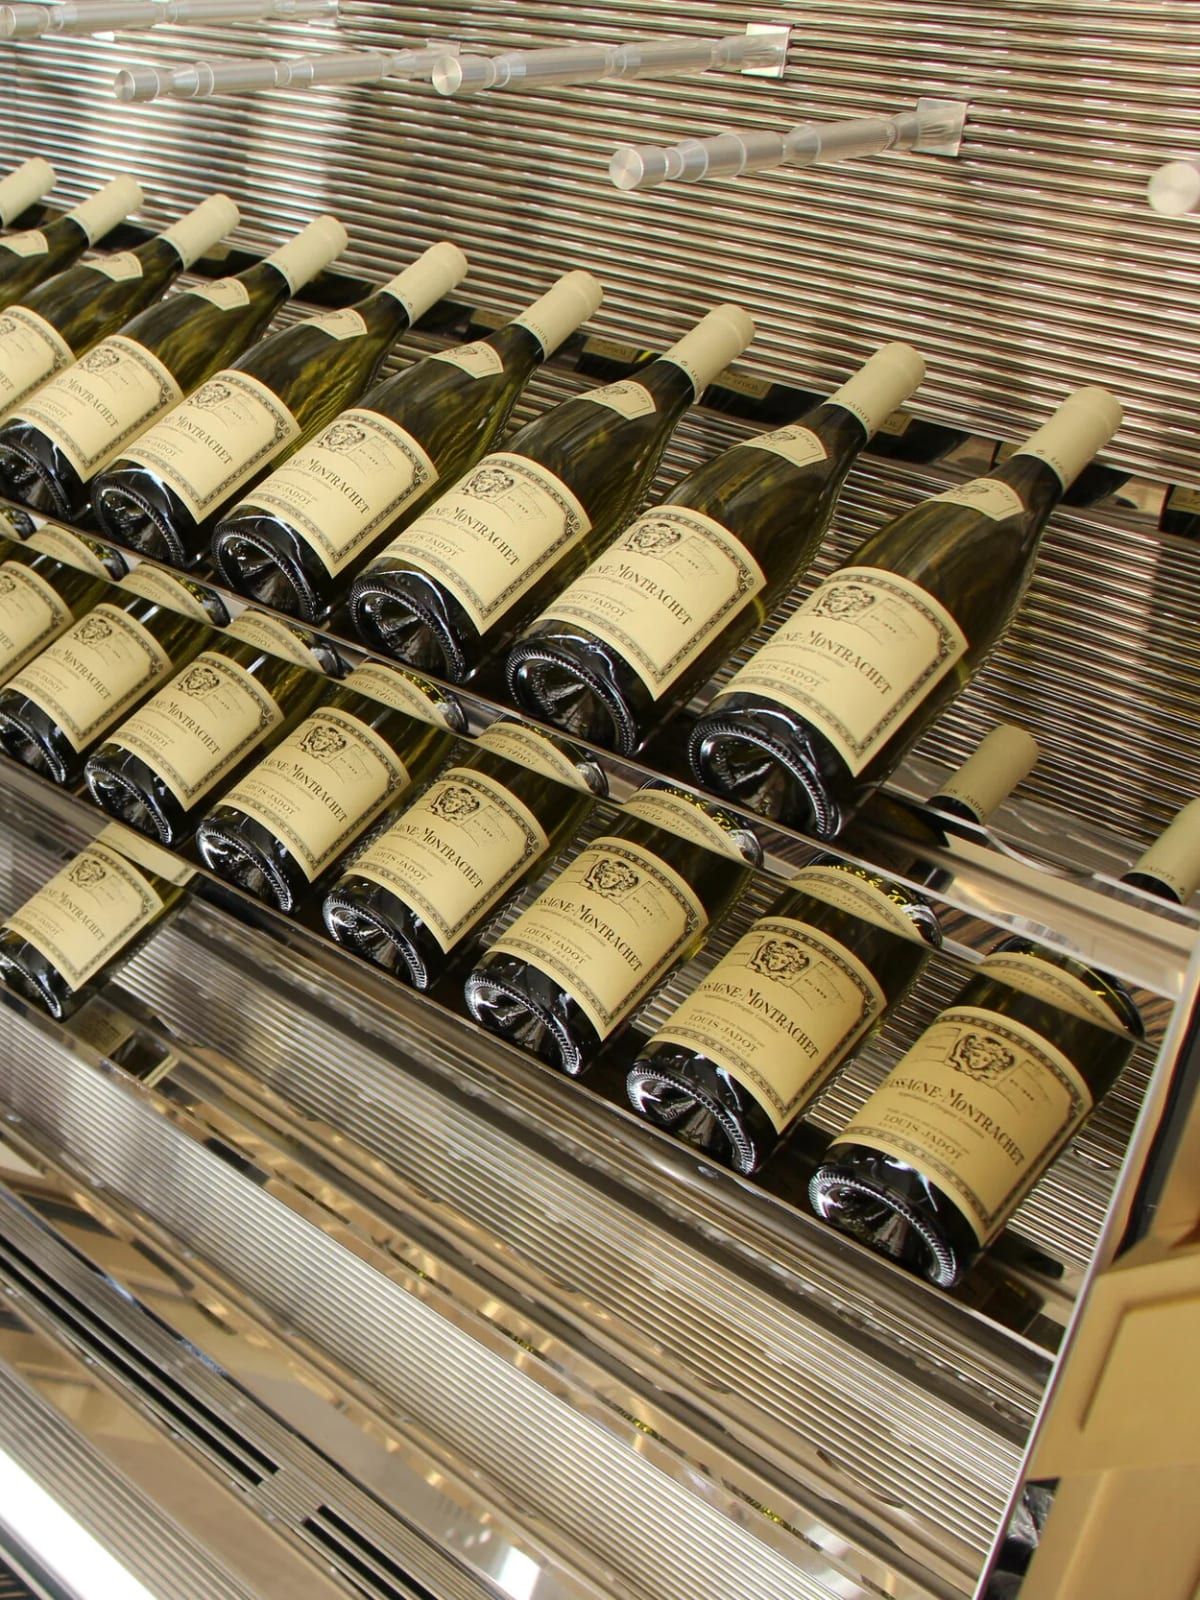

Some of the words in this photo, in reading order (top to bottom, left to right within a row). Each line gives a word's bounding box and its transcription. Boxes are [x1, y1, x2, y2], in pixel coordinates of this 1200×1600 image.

[590, 597, 629, 618] JADOT
[781, 666, 823, 688] JADOT
[397, 858, 427, 881] JADOT
[524, 927, 552, 942] LOUIS
[552, 940, 586, 964] JADOT
[688, 1014, 720, 1028] LOUIS
[720, 1026, 758, 1052] JADOT
[883, 1113, 920, 1133] LOUIS
[921, 1130, 963, 1160] JADOT
